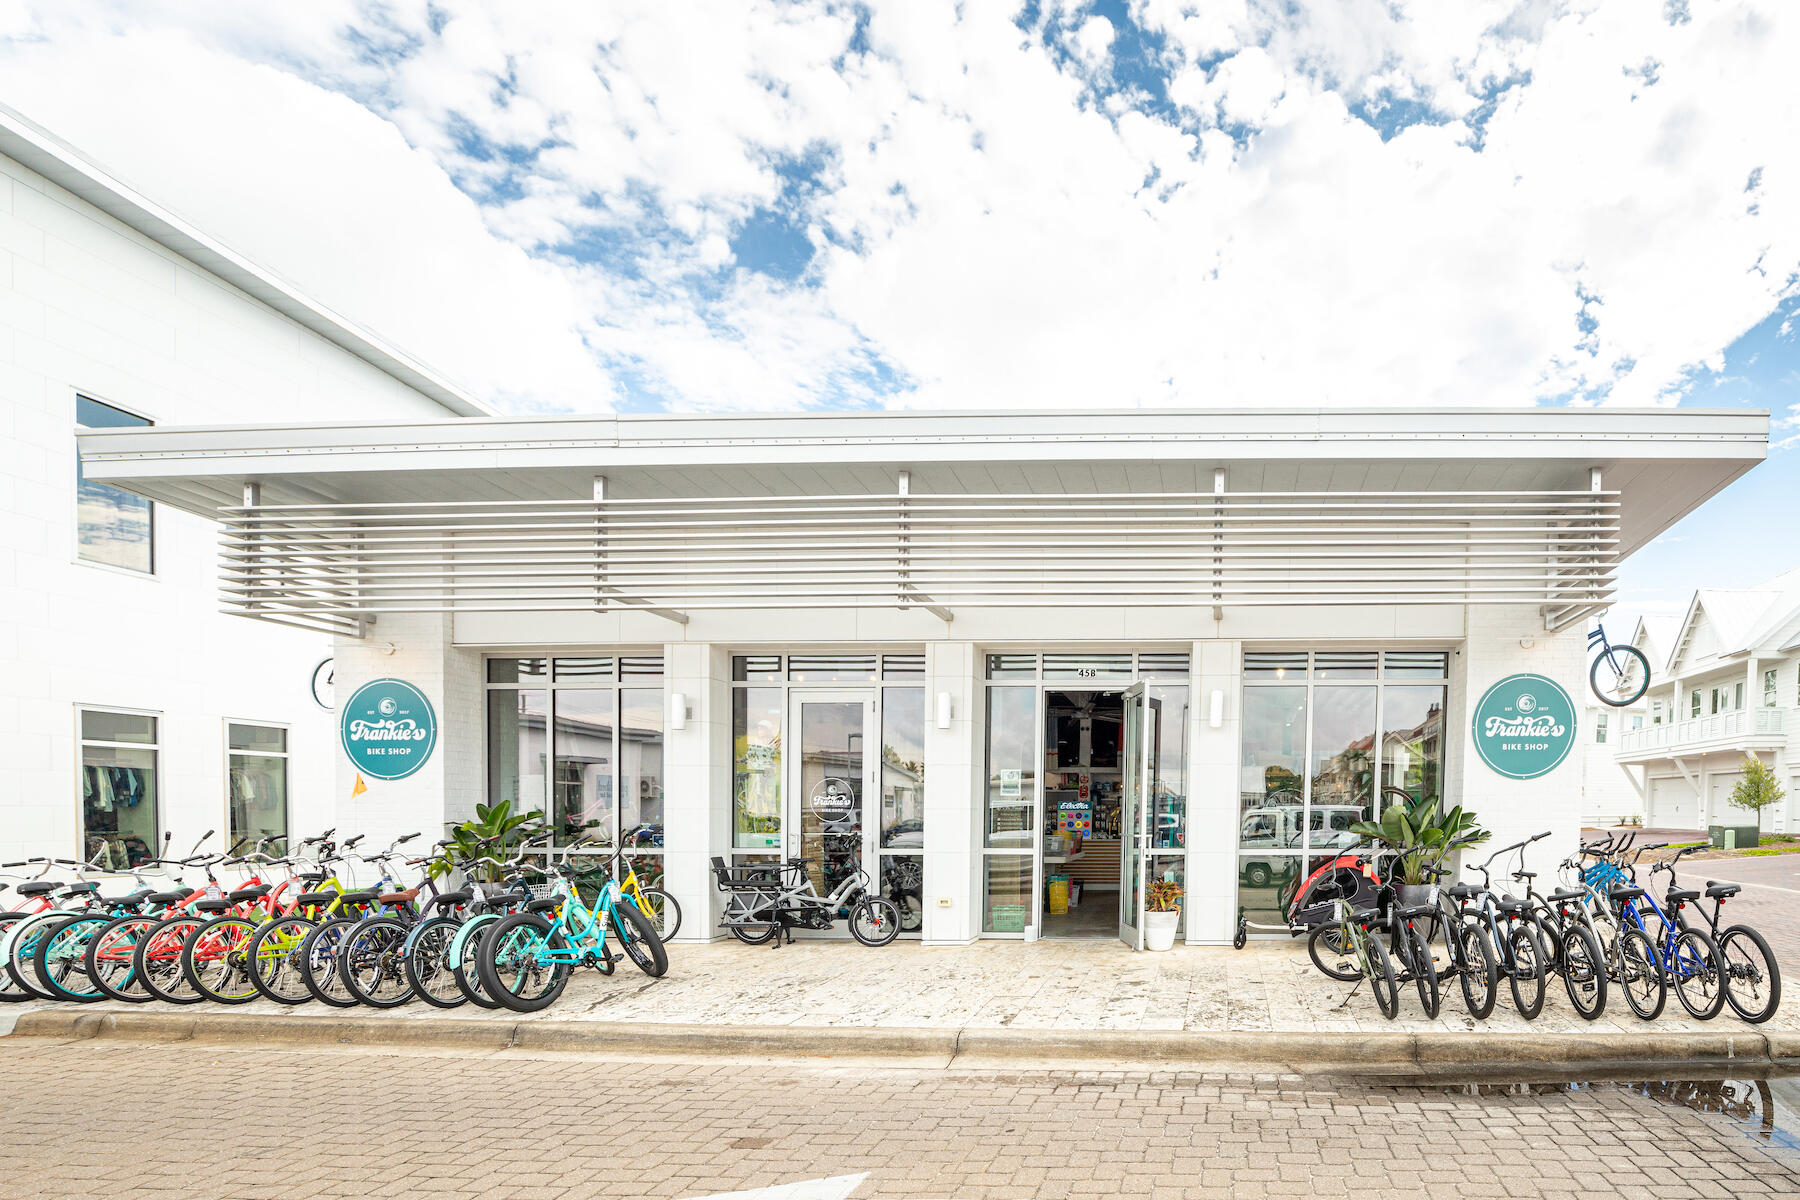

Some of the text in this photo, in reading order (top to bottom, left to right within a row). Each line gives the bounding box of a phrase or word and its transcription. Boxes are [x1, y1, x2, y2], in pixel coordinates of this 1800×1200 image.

[366, 747, 412, 755] BIKE SHOP
[1502, 743, 1549, 751] BIKE SHOP
[1060, 802, 1089, 810] Electra
